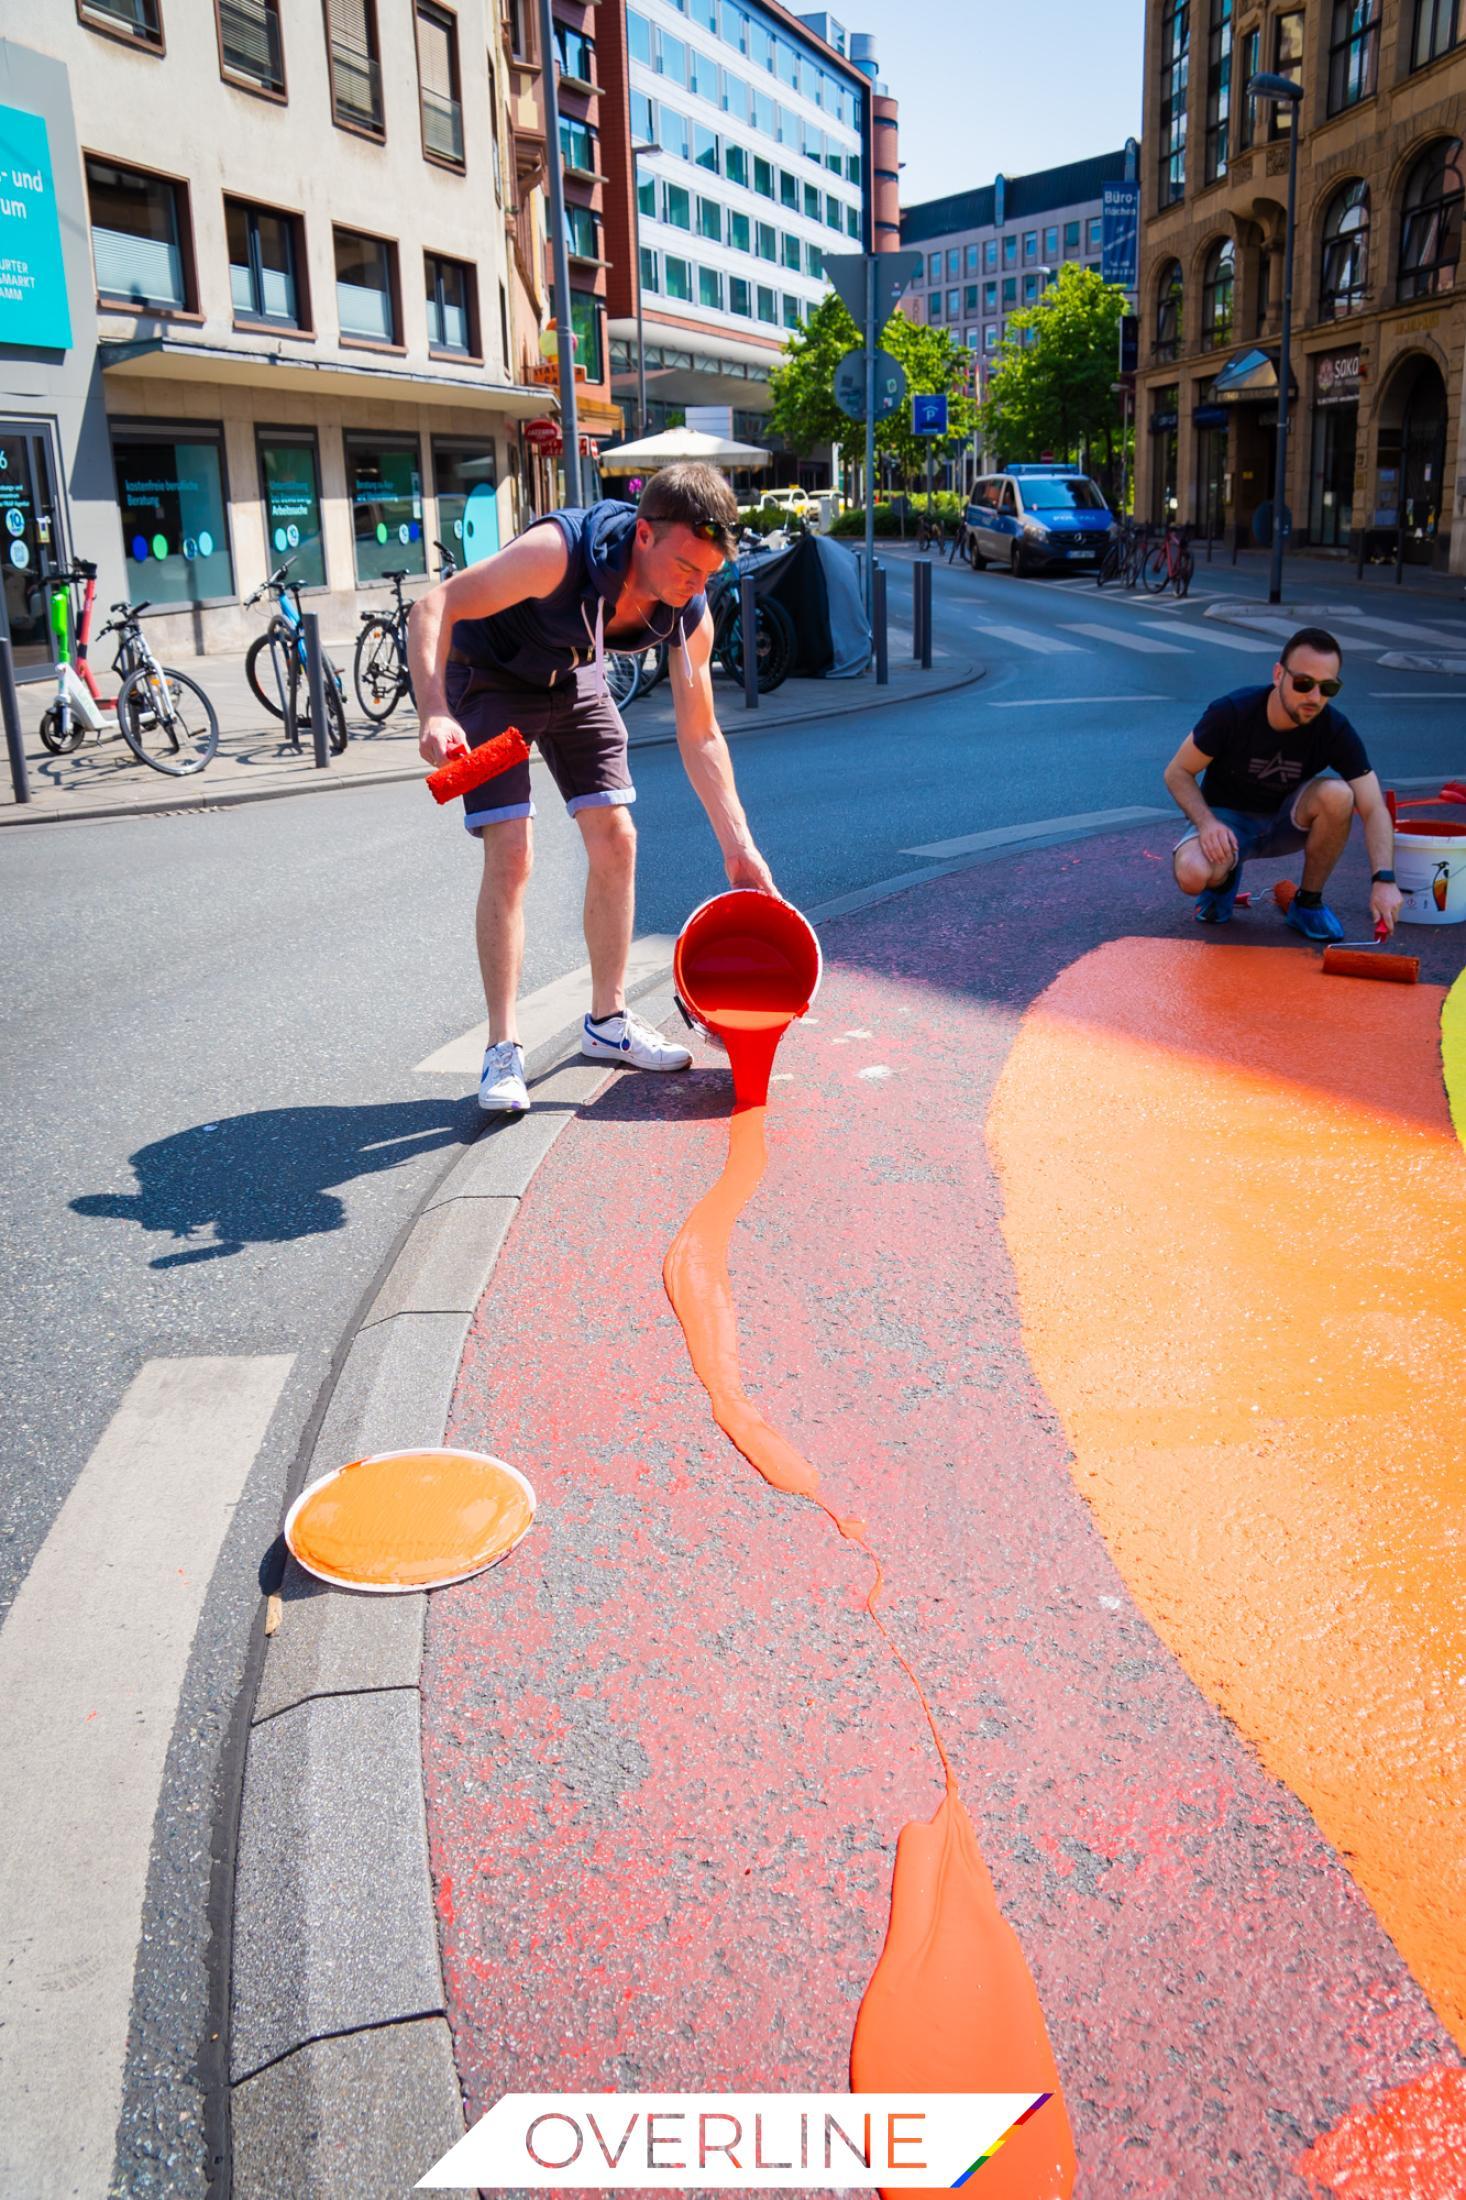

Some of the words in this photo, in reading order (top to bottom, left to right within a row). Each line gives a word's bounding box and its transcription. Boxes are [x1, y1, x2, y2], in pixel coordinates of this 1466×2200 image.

[12, 169, 43, 192] und
[1104, 190, 1137, 204] Büro-
[0, 198, 27, 219] um
